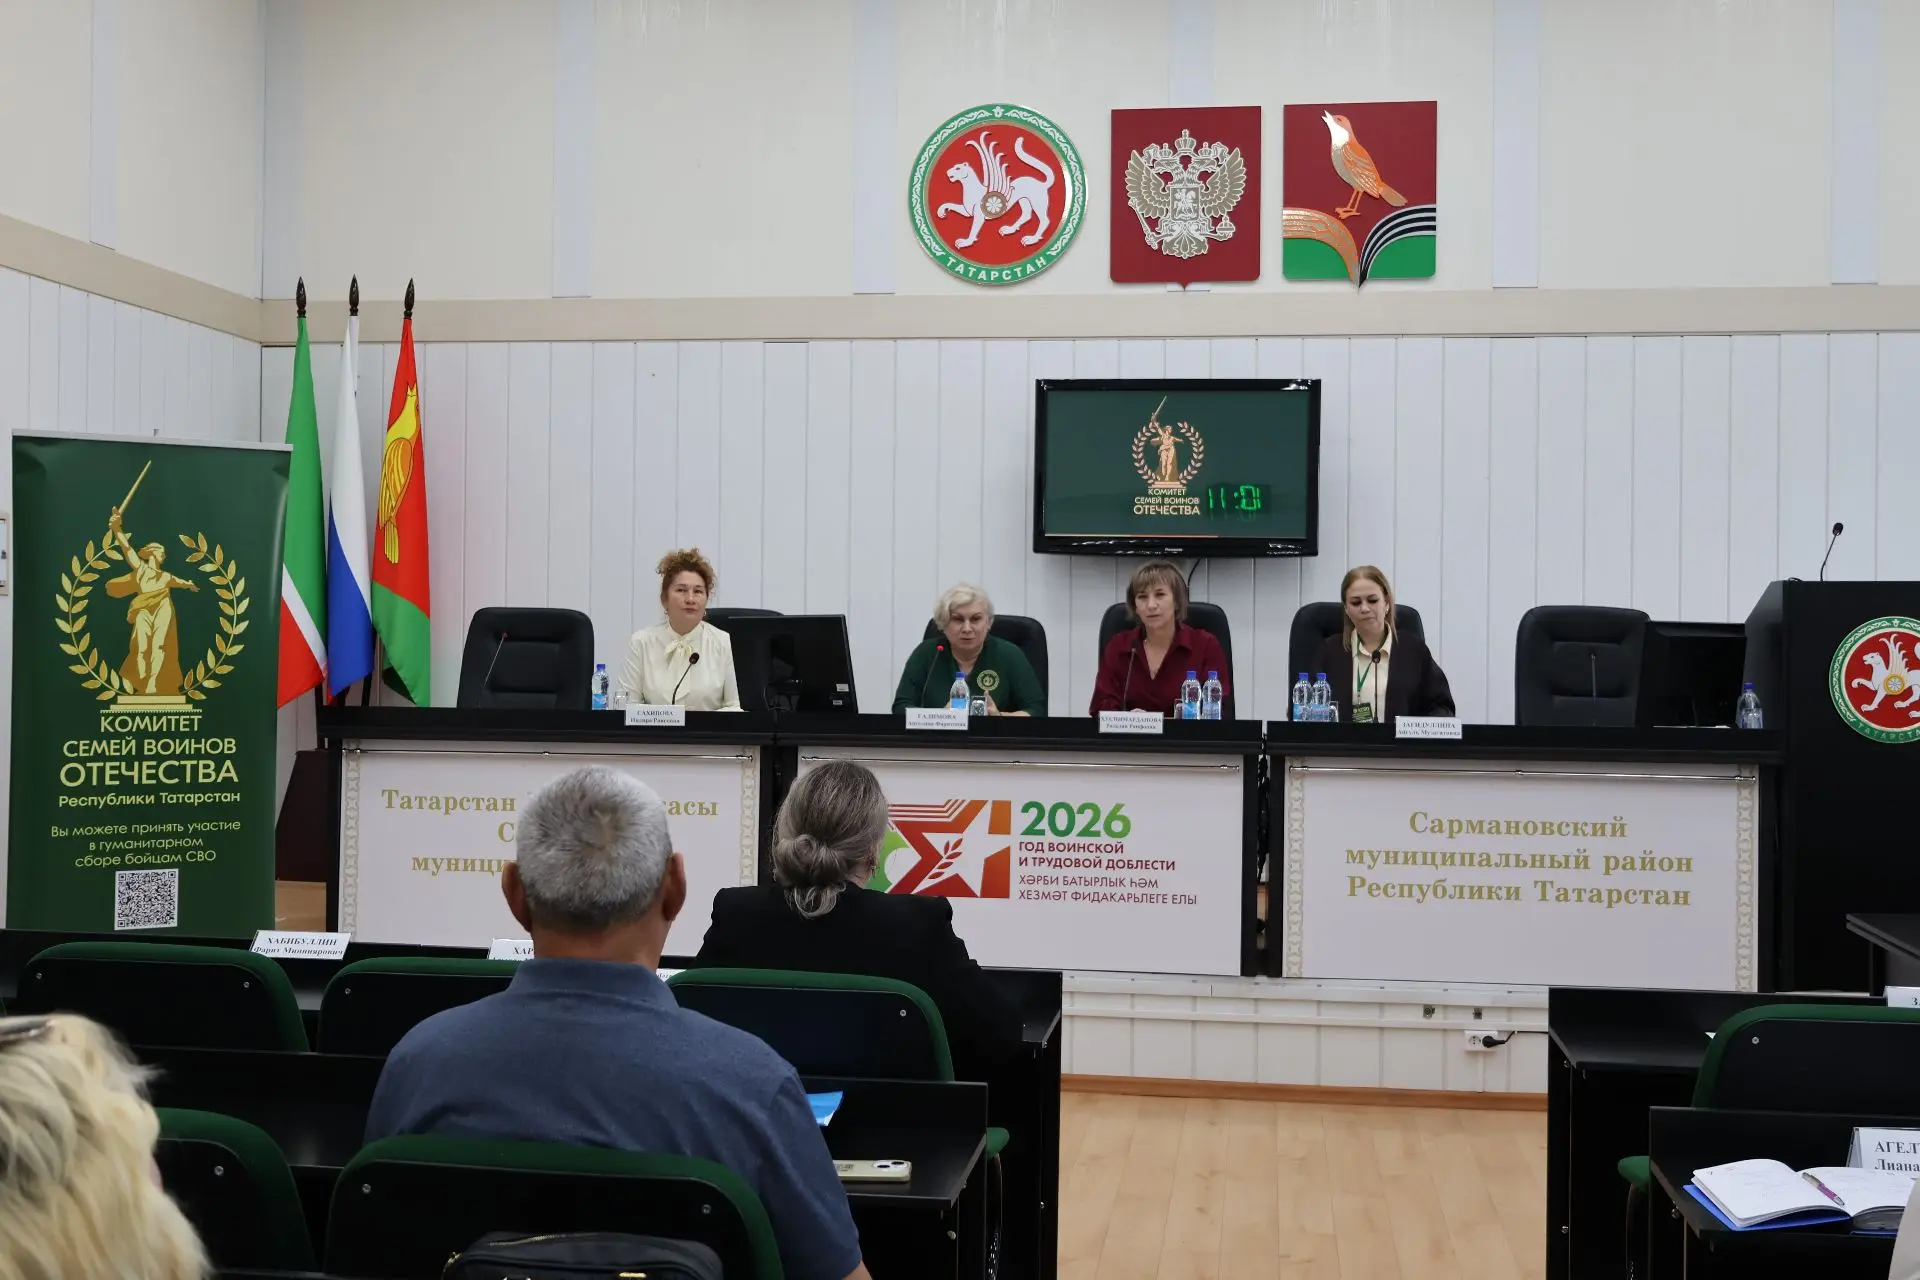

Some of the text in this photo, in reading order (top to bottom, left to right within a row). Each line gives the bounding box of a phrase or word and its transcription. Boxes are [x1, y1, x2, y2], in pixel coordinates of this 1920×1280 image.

[946, 256, 1047, 281] ТАТАРСТАН
[1134, 496, 1200, 505] СЕМЕЙ ВОИНОВ
[1148, 488, 1187, 496] КОМИТЕТ
[1133, 505, 1200, 515] ОТЕЧЕСТВА
[100, 715, 202, 733] КОМИТЕТ
[63, 736, 237, 758] СЕМЕЙ ВОИНОВ
[59, 759, 239, 787] ОТЕЧЕСТВА
[58, 792, 241, 809] Республики Татарстан
[381, 789, 517, 815] Татарстан
[1020, 801, 1131, 838] 2026
[1409, 811, 1628, 839] Сармановский
[51, 820, 241, 837] Вы можете принять участие
[89, 838, 203, 853] в гуманитарном
[1019, 841, 1124, 854] ГОД ВОИНСКОЙ
[75, 850, 217, 868] сборе бойцам СВО
[411, 856, 516, 876] муници
[1019, 856, 1176, 871] И ТРУДОВОЙ ДОБЛЕСТИ
[1344, 848, 1694, 875] муниципальный район
[1019, 874, 1059, 886] ХӘРБИ
[1062, 876, 1126, 887] БАТЫРЛЫК
[1019, 890, 1197, 905] ХЕЗМӘТ ФИДАКАРЬЛЕГЕ ЕЛЫ
[1347, 876, 1691, 909] Республики Татарстан
[268, 937, 337, 946] ХАБИБУЛЛИН
[513, 947, 534, 955] ХАР
[1873, 1140, 1920, 1154] АГЕЛ
[1873, 1158, 1920, 1172] Лиана
